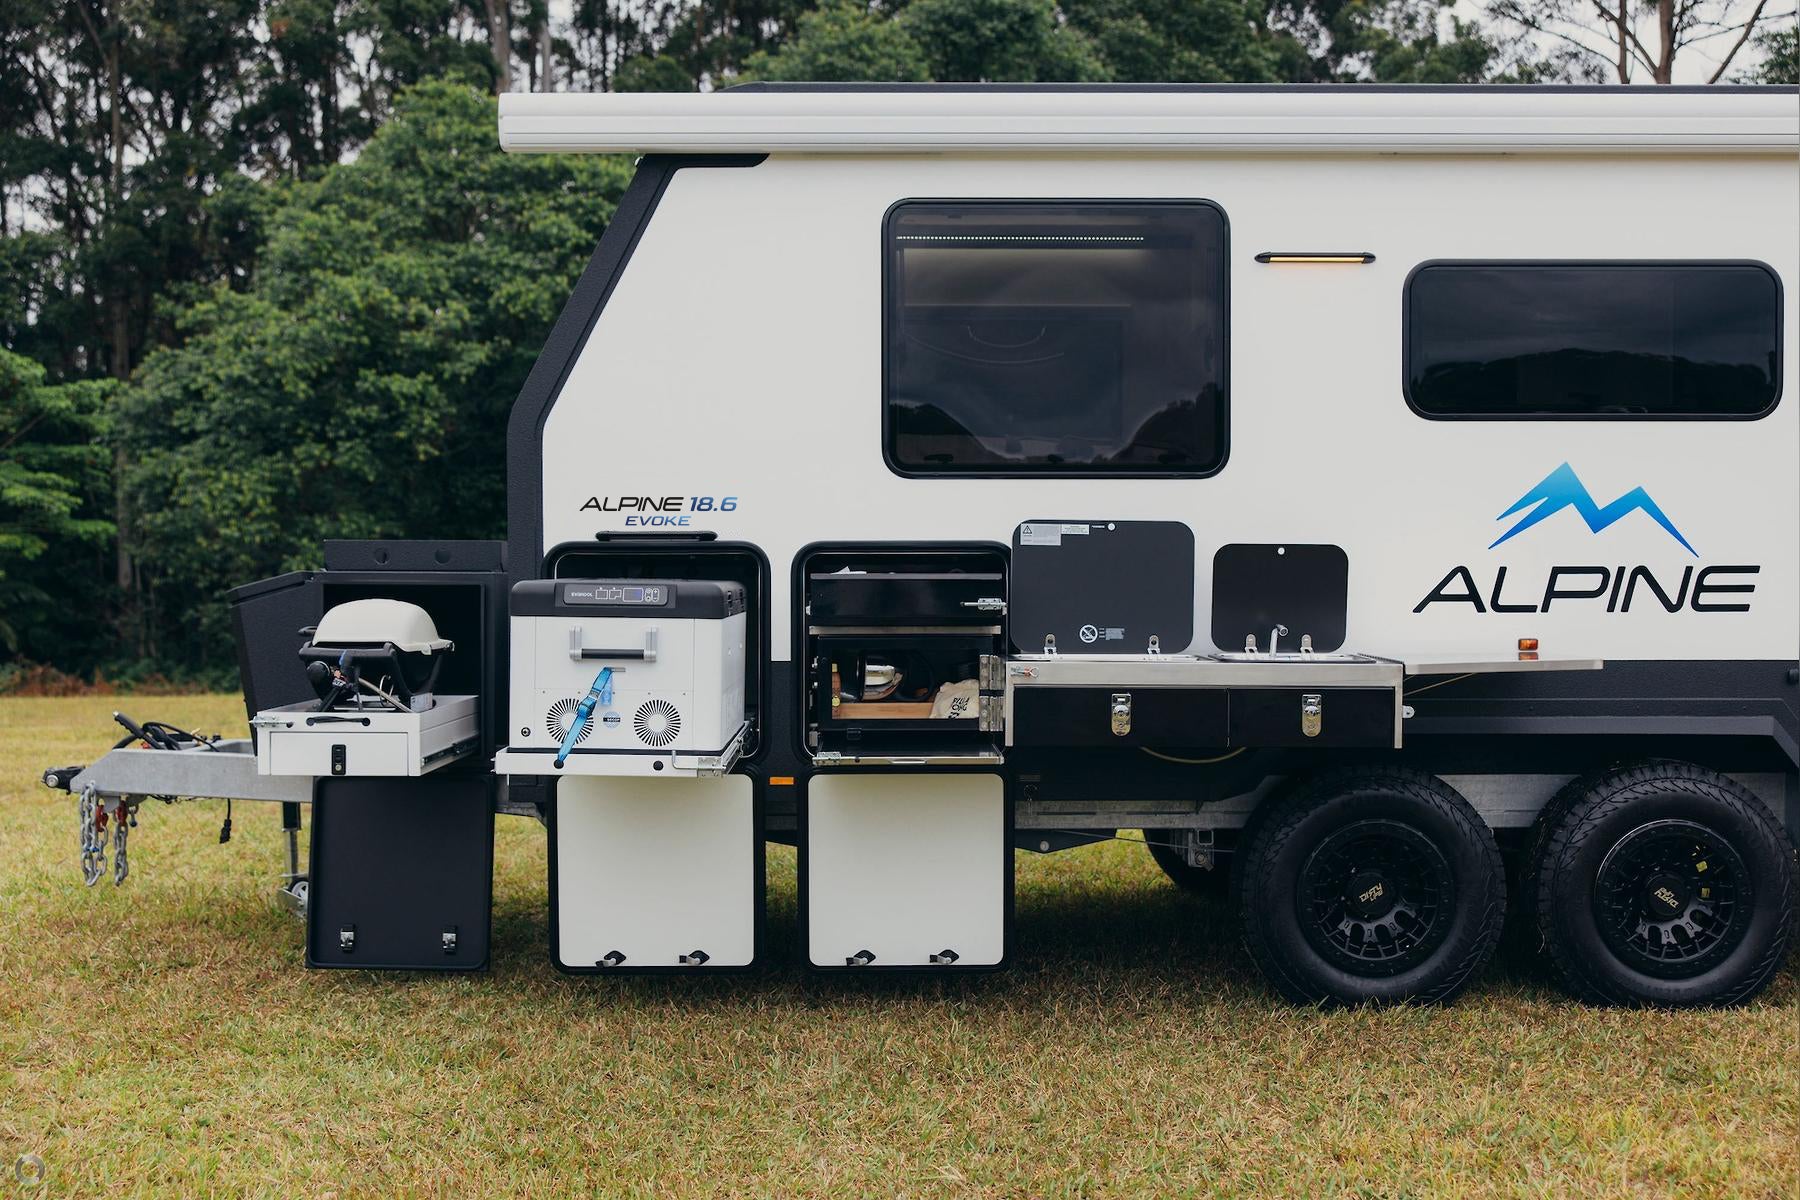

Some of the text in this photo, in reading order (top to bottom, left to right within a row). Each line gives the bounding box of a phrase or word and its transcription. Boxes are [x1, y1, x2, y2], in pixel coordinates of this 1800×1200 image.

[579, 496, 738, 512] ALPINE 18.6
[625, 515, 692, 527] EVOKE
[1412, 565, 1761, 613] ALPINE
